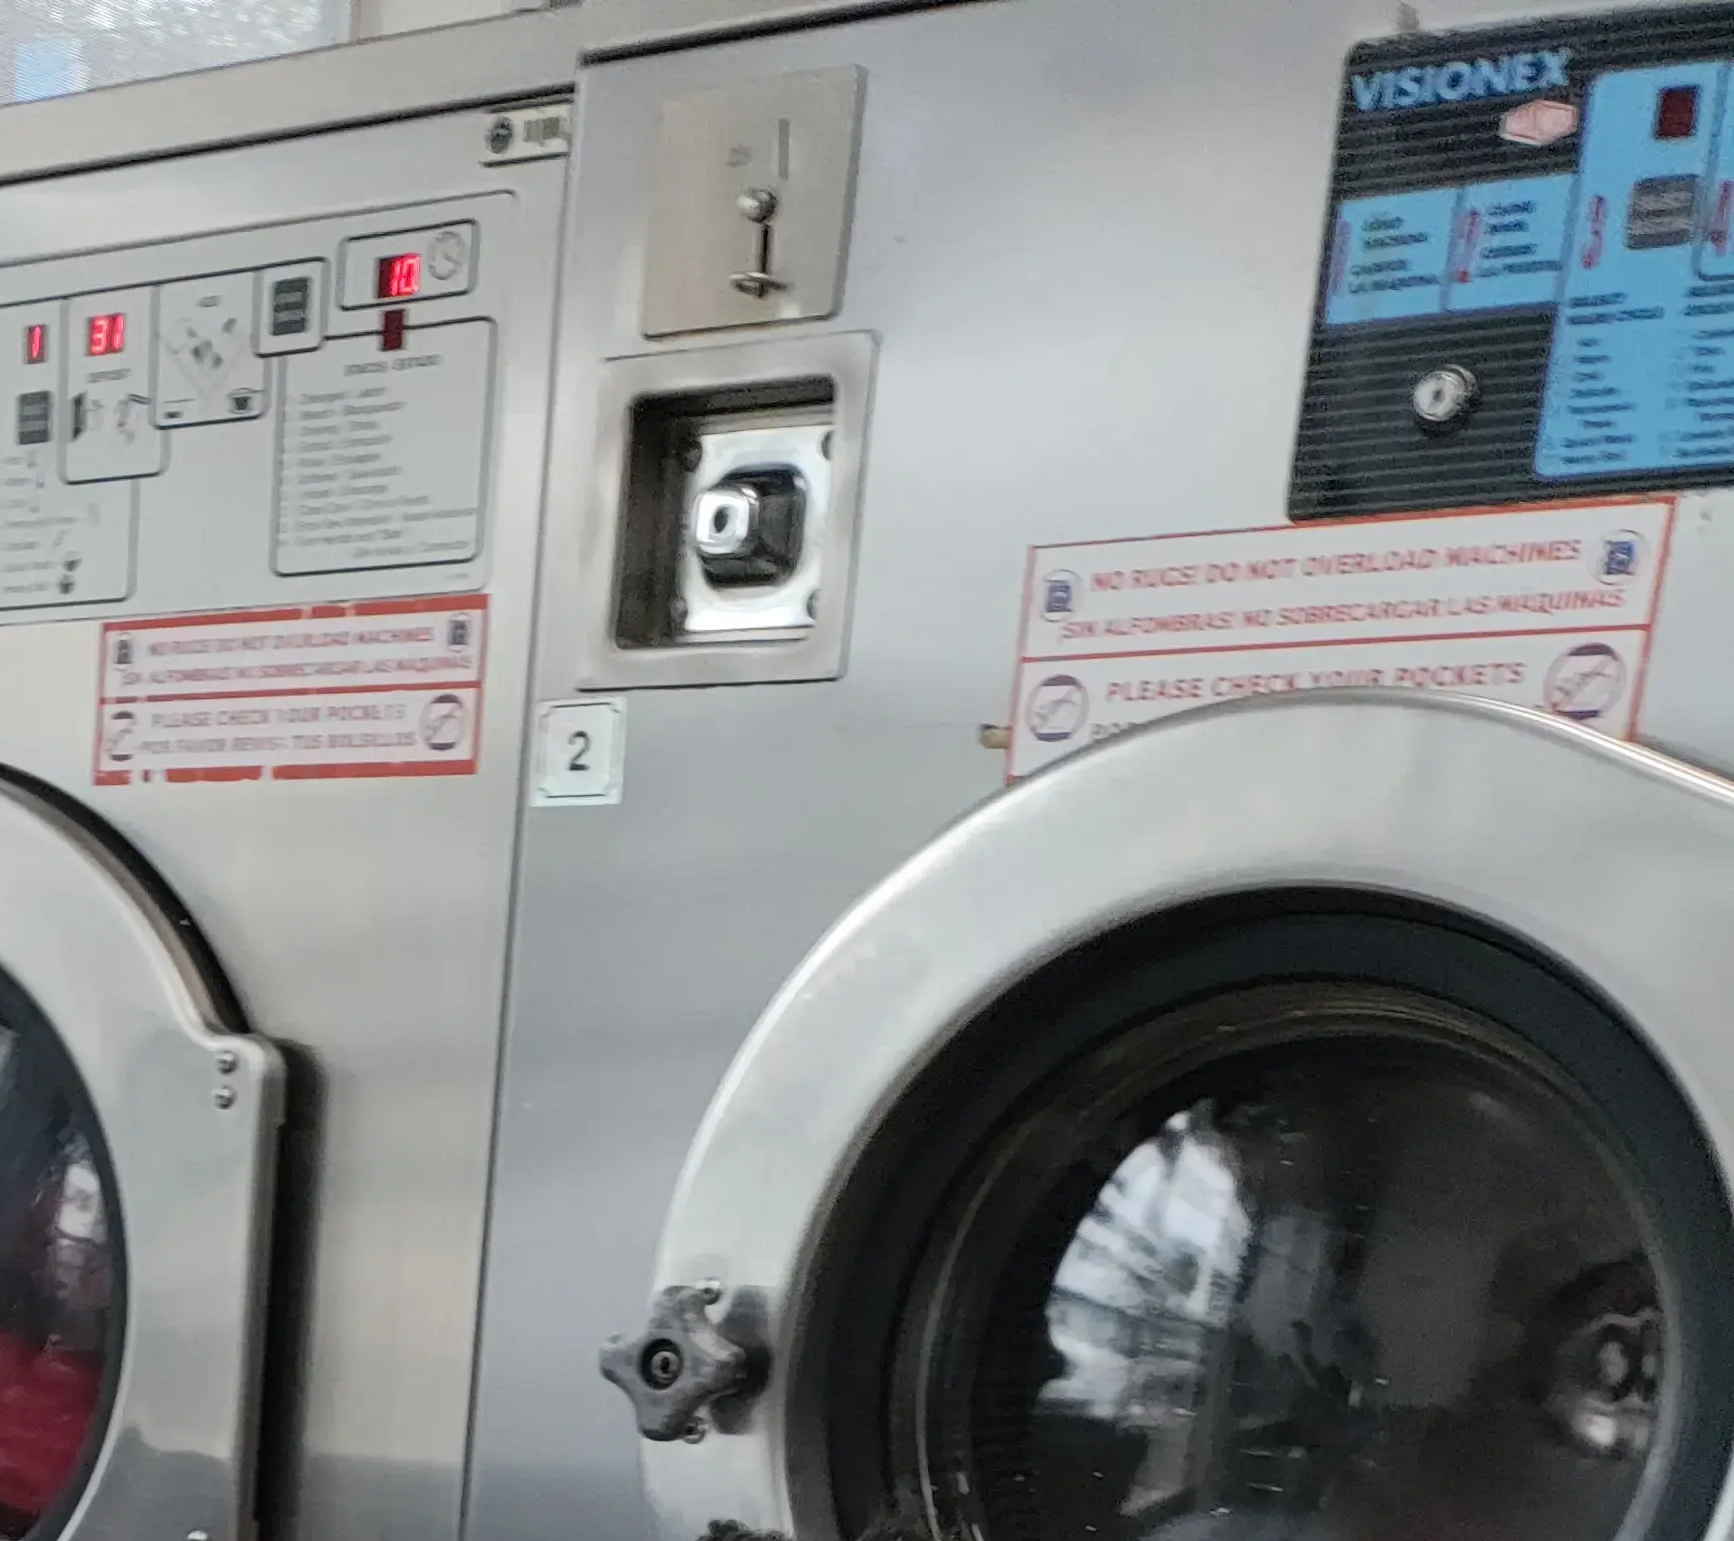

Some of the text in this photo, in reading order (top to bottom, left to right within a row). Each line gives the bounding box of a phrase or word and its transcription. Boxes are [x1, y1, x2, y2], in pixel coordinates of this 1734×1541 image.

[1350, 49, 1570, 111] VISIONEX
[89, 313, 125, 355] 31
[1107, 678, 1204, 702] PLEASE
[1394, 661, 1525, 688] POCKETS
[568, 731, 590, 771] 2
